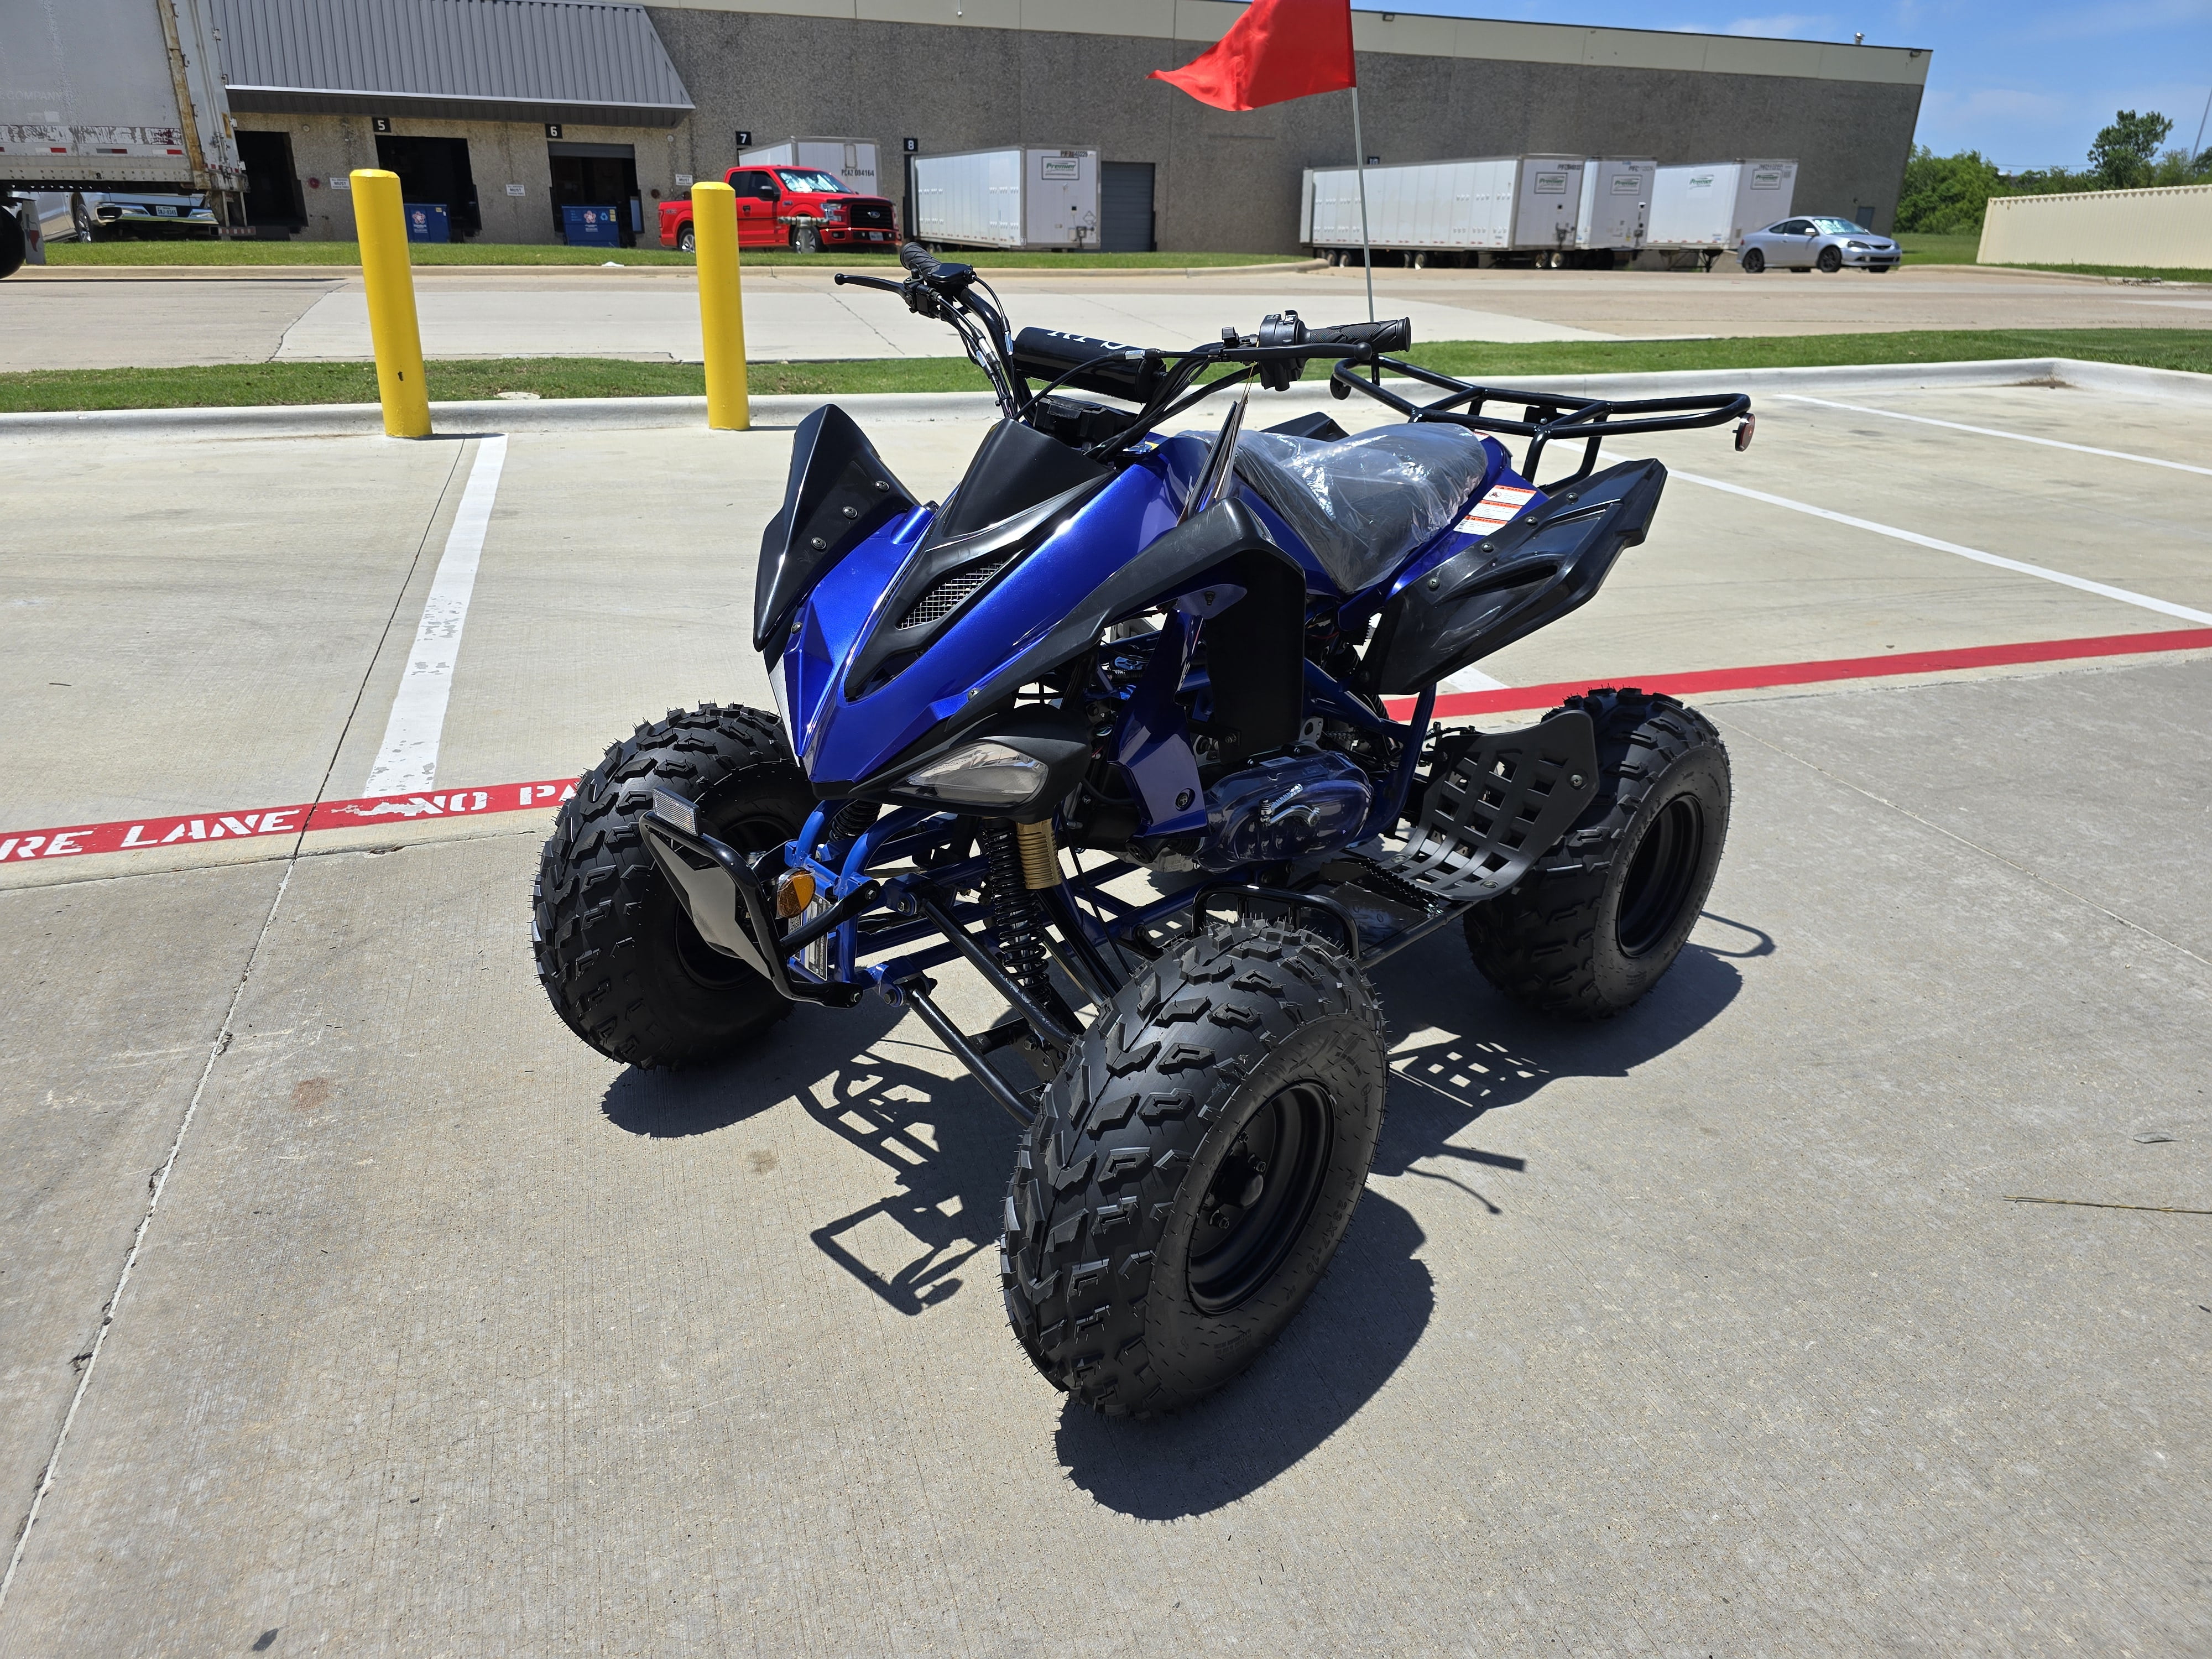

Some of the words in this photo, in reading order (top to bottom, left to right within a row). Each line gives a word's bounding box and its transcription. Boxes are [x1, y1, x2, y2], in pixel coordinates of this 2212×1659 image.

[378, 120, 385, 131] 5
[550, 126, 557, 137] 6
[740, 133, 747, 144] 7
[907, 140, 914, 150] 8
[121, 810, 301, 847] LANE
[403, 791, 488, 817] NO
[1345, 1171, 1358, 1191] AT
